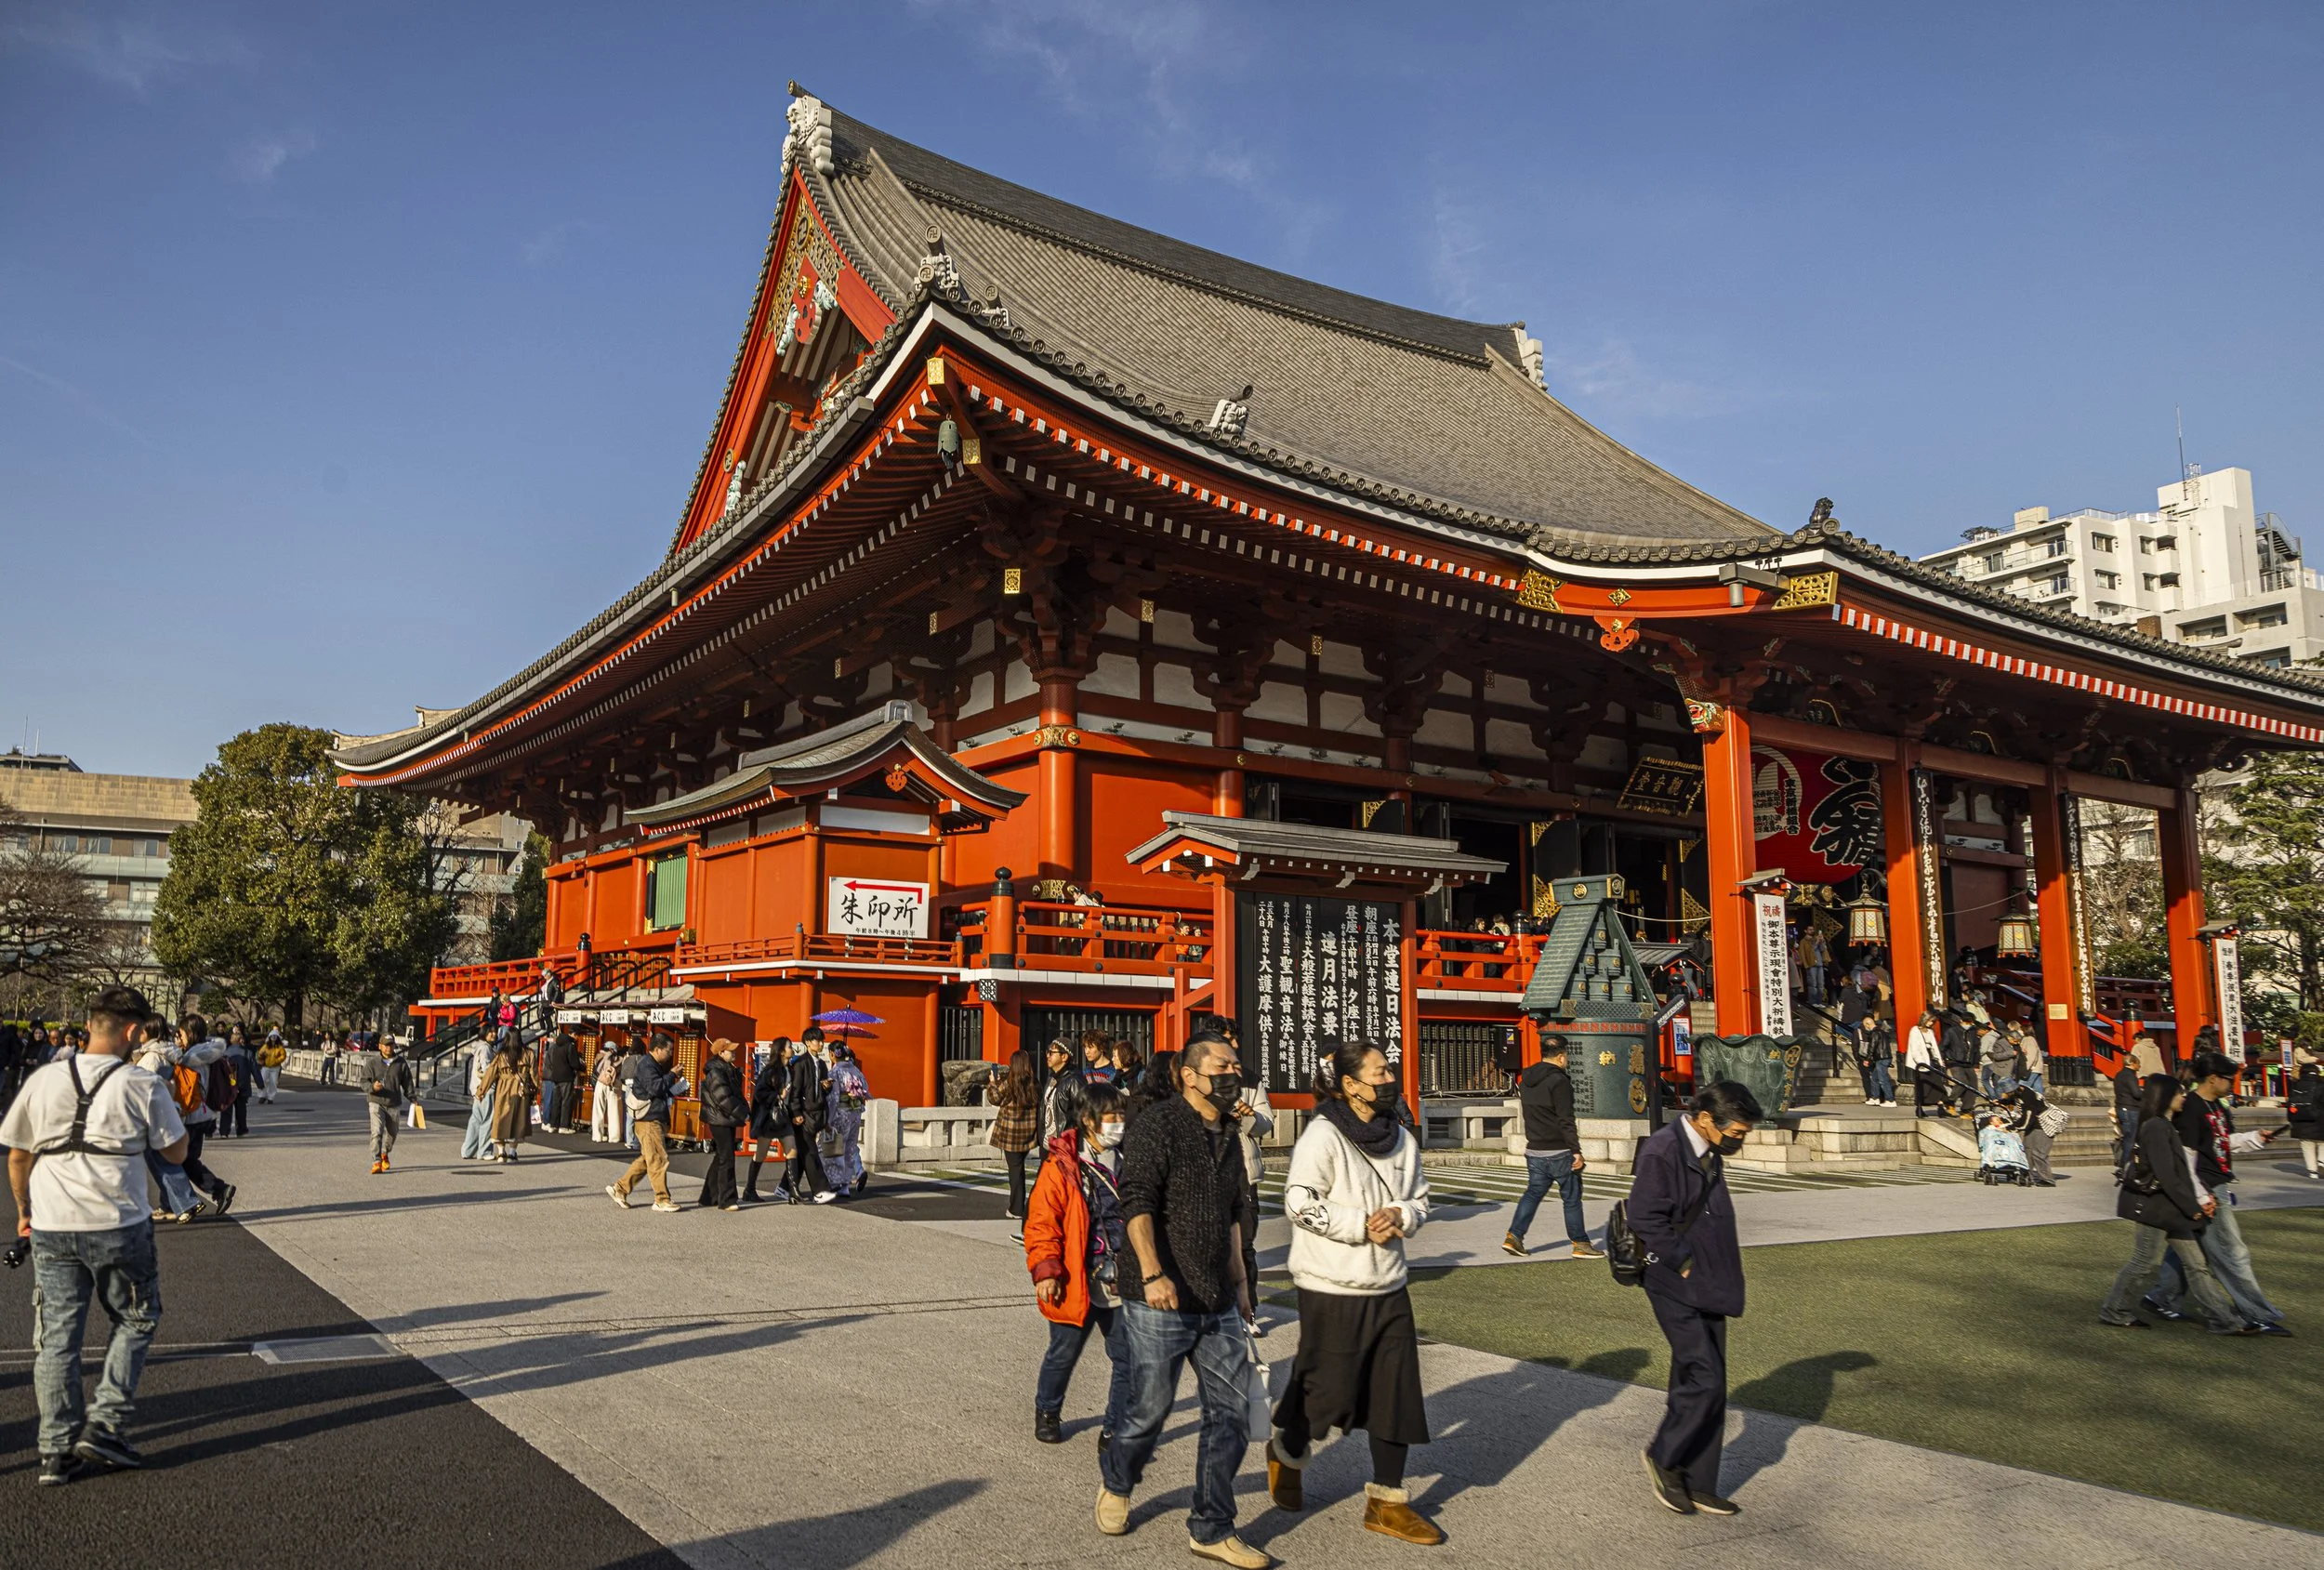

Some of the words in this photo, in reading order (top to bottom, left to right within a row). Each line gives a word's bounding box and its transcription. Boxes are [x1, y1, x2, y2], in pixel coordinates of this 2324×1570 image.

[840, 892, 918, 929] 朱印所
[1364, 905, 1378, 935] 朝座
[1320, 930, 1340, 1036] 連月法要
[1382, 917, 1403, 1064] 本堂連日法会
